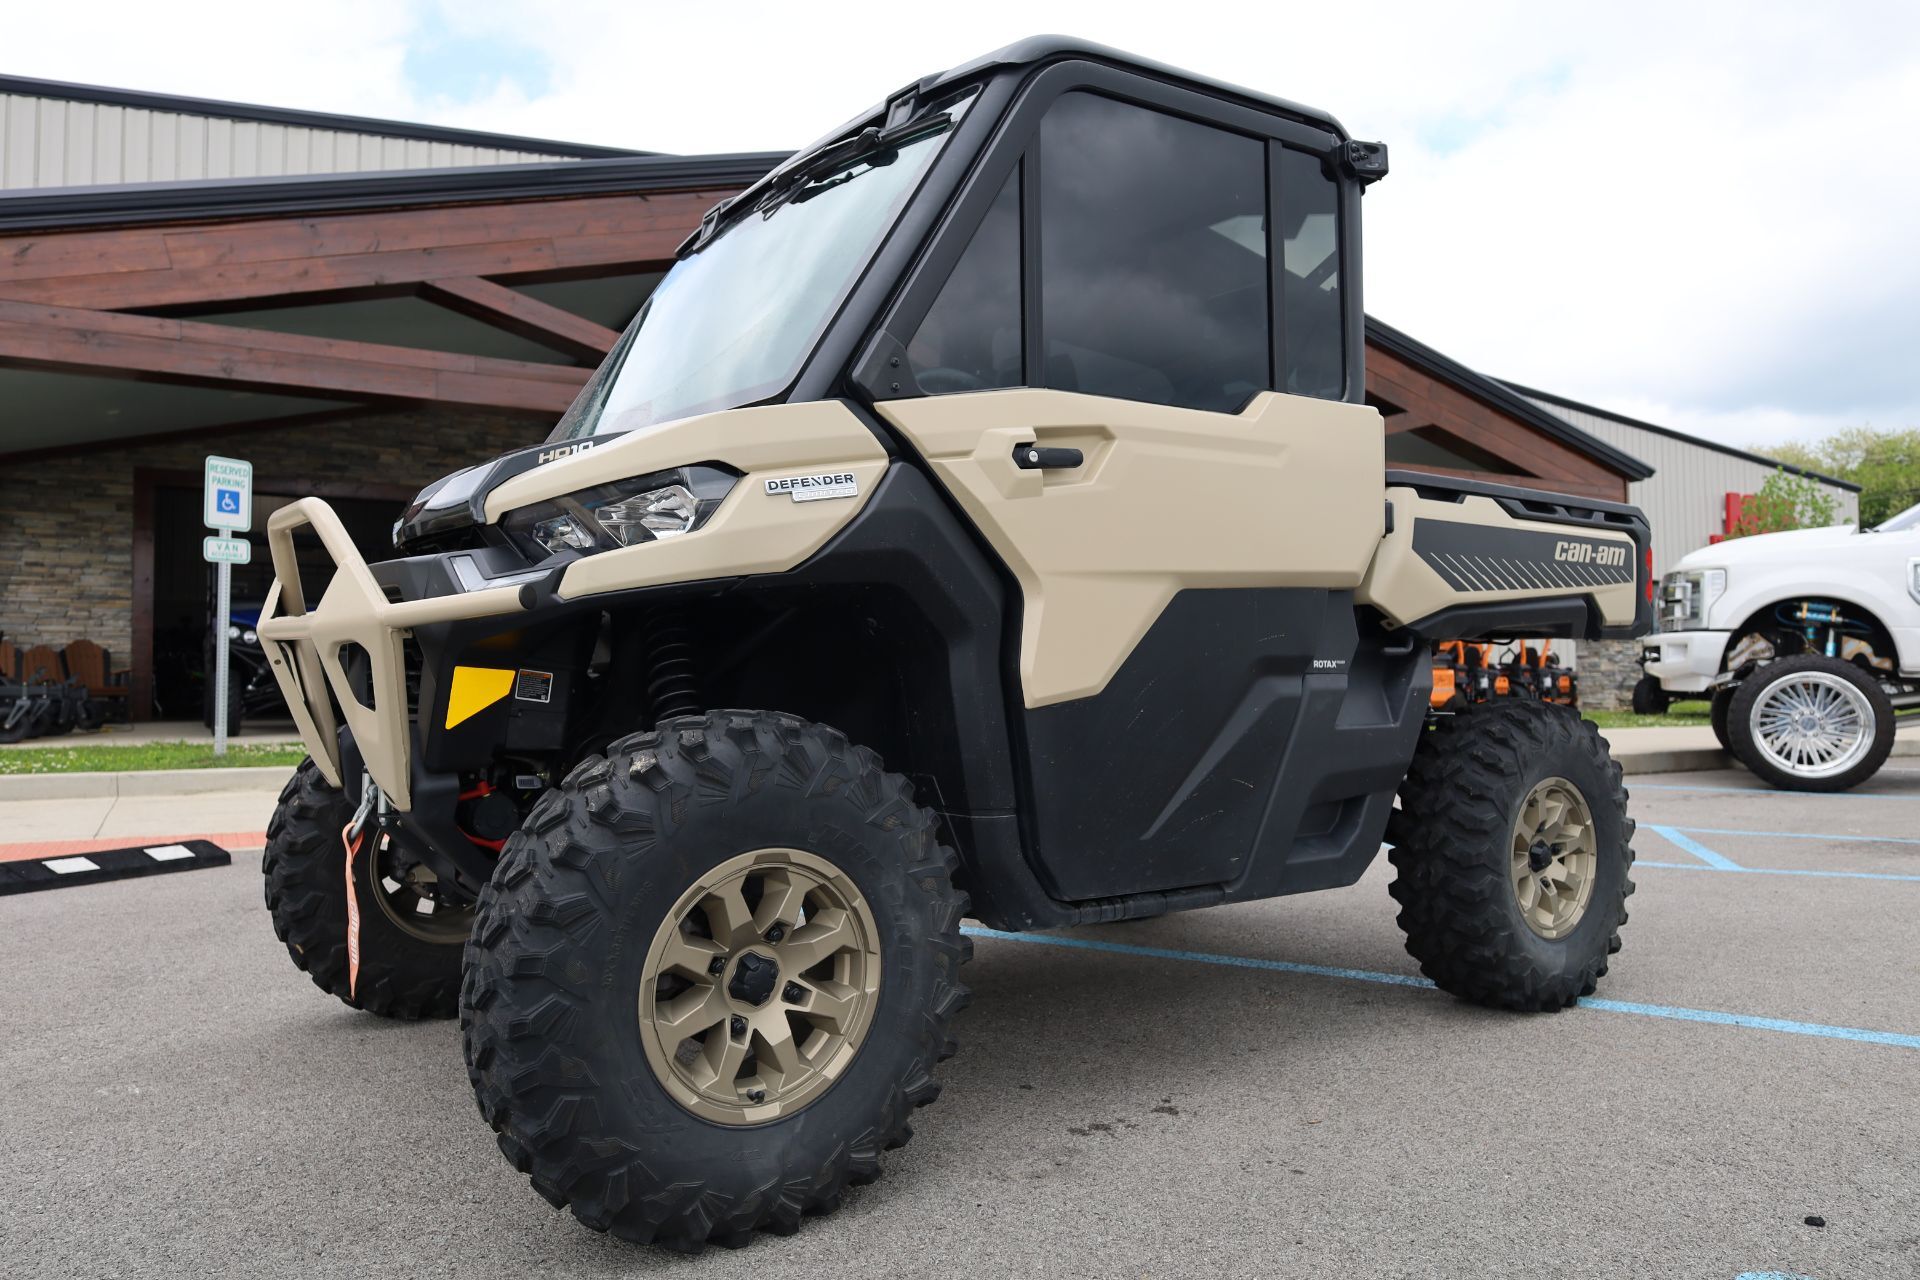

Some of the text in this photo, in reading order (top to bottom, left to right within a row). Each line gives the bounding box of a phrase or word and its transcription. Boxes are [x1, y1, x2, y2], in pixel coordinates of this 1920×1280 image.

[538, 441, 594, 464] HD10
[209, 464, 249, 478] RESERVED
[211, 475, 246, 489] PARKING
[767, 473, 854, 491] DEFENDER
[216, 543, 239, 551] VAN
[1555, 541, 1626, 567] can-am
[1313, 660, 1337, 669] ROTAX
